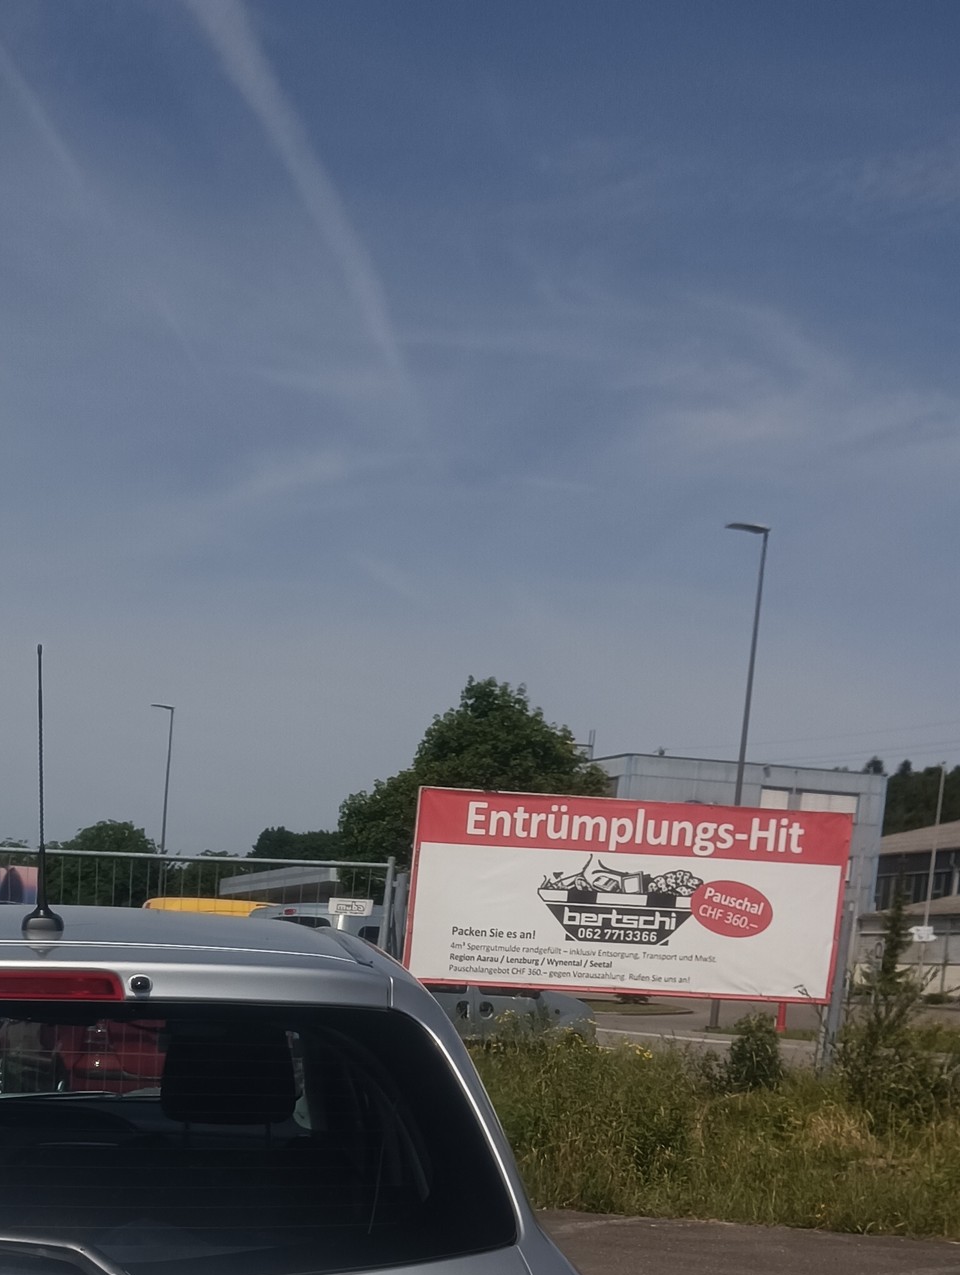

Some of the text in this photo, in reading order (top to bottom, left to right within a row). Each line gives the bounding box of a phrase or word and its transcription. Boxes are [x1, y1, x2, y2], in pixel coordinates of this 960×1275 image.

[466, 800, 805, 857] Entrümplungs-Hit
[704, 887, 765, 916] Pauschal
[563, 906, 677, 930] bertschi
[698, 904, 723, 919] CHF
[451, 926, 536, 940] Packen Sie es an!
[577, 928, 658, 942] 062 7713366
[449, 953, 475, 962] Region
[476, 954, 499, 963] Aarau
[506, 955, 540, 966] Lenzburg
[546, 957, 583, 968] Wynental
[589, 960, 613, 969] Seetal
[467, 943, 521, 953] Sperrgutmulde
[522, 945, 562, 955] randgefüllt
[569, 948, 596, 956] inklusiv
[642, 951, 678, 961] Transport
[679, 953, 693, 962] und
[449, 964, 510, 975] Pauschalangebot
[511, 967, 526, 975] CHF
[548, 970, 571, 979] gegen
[628, 973, 650, 982] Rufen
[652, 973, 663, 982] Sie
